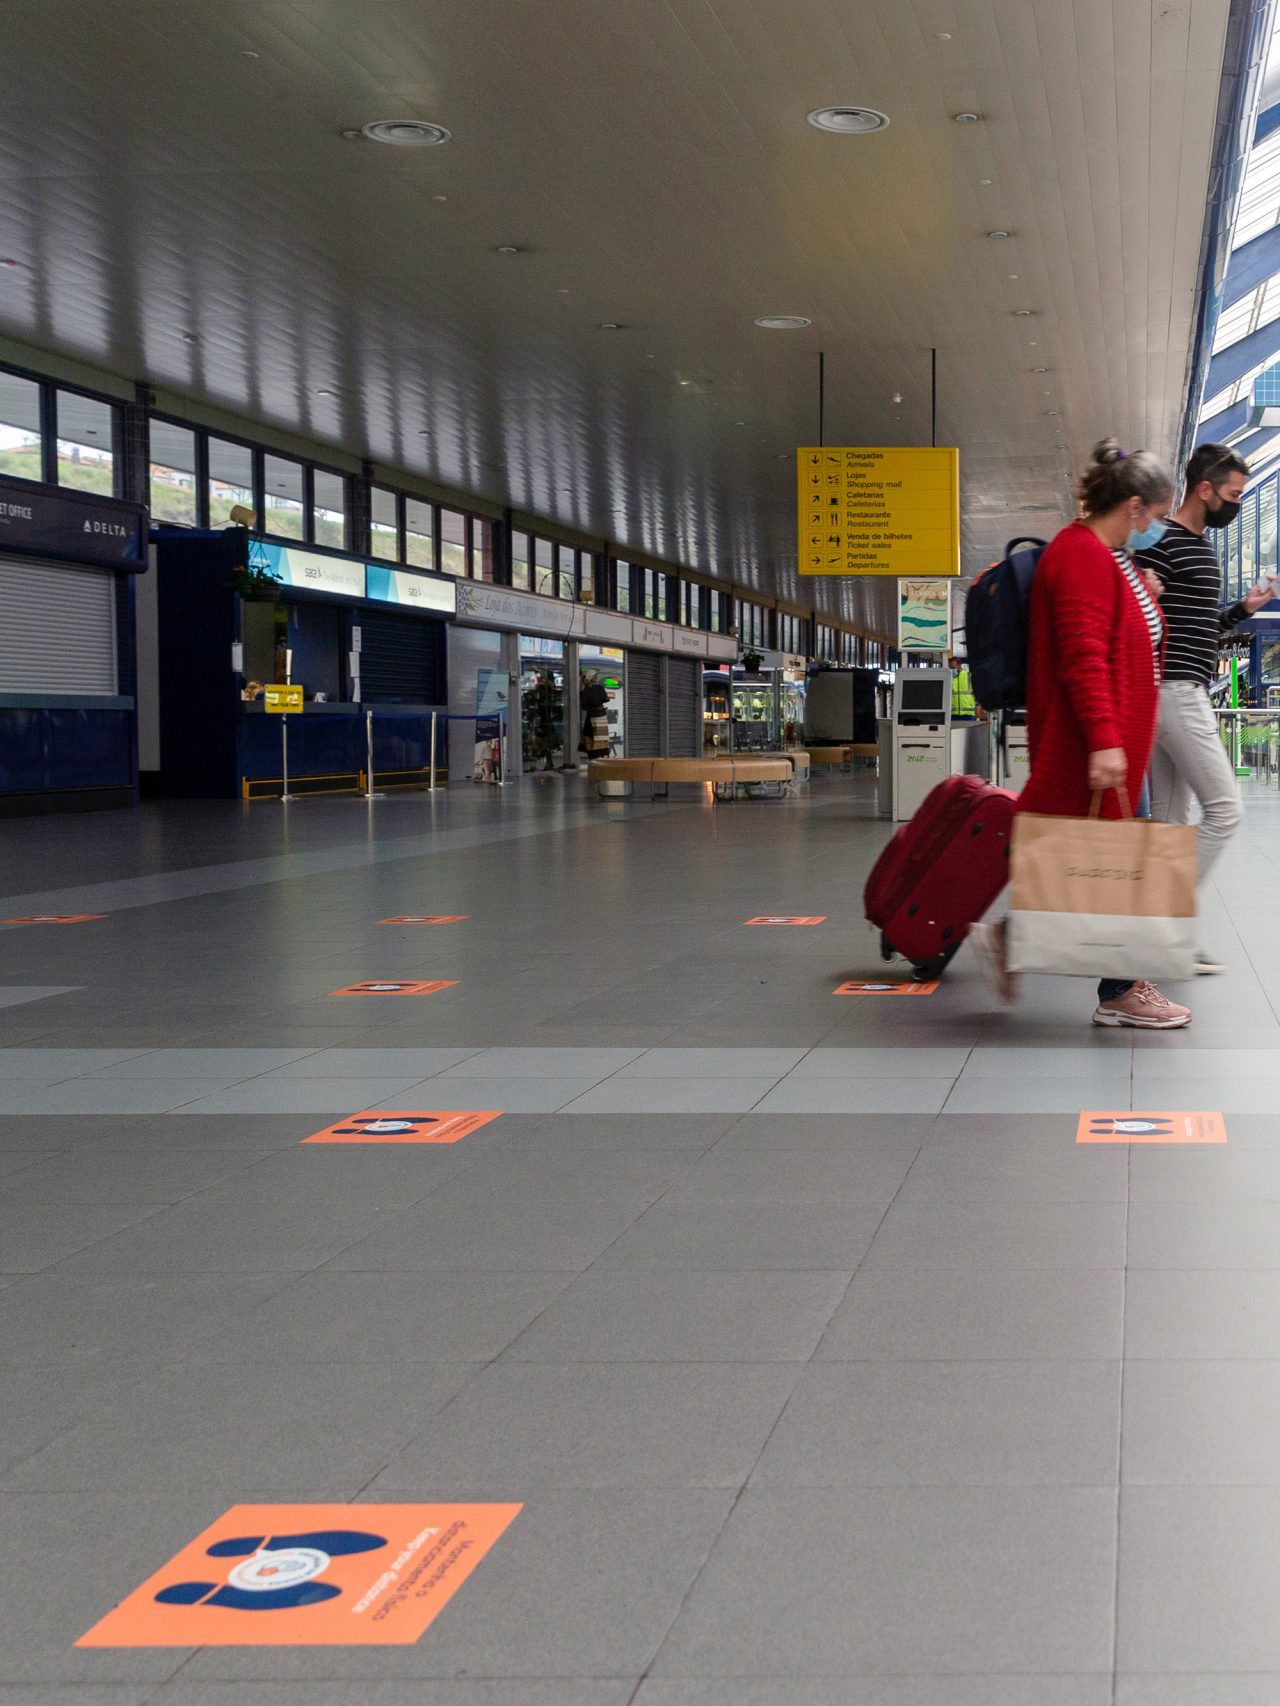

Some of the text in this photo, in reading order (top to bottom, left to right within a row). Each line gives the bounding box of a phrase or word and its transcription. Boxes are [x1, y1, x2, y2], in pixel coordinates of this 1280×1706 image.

[846, 452, 884, 460] Chegadas
[846, 472, 866, 480] Lojas
[847, 481, 883, 489] Shopping
[8, 504, 32, 520] OFFICE
[847, 520, 889, 528] Restaurant
[94, 521, 127, 537] DELTA
[846, 552, 878, 560] Partidas
[847, 561, 890, 569] Departures
[397, 1520, 467, 1592] distanciamento
[422, 1540, 474, 1588] Mantenha
[351, 1527, 440, 1613] Keep your distance
